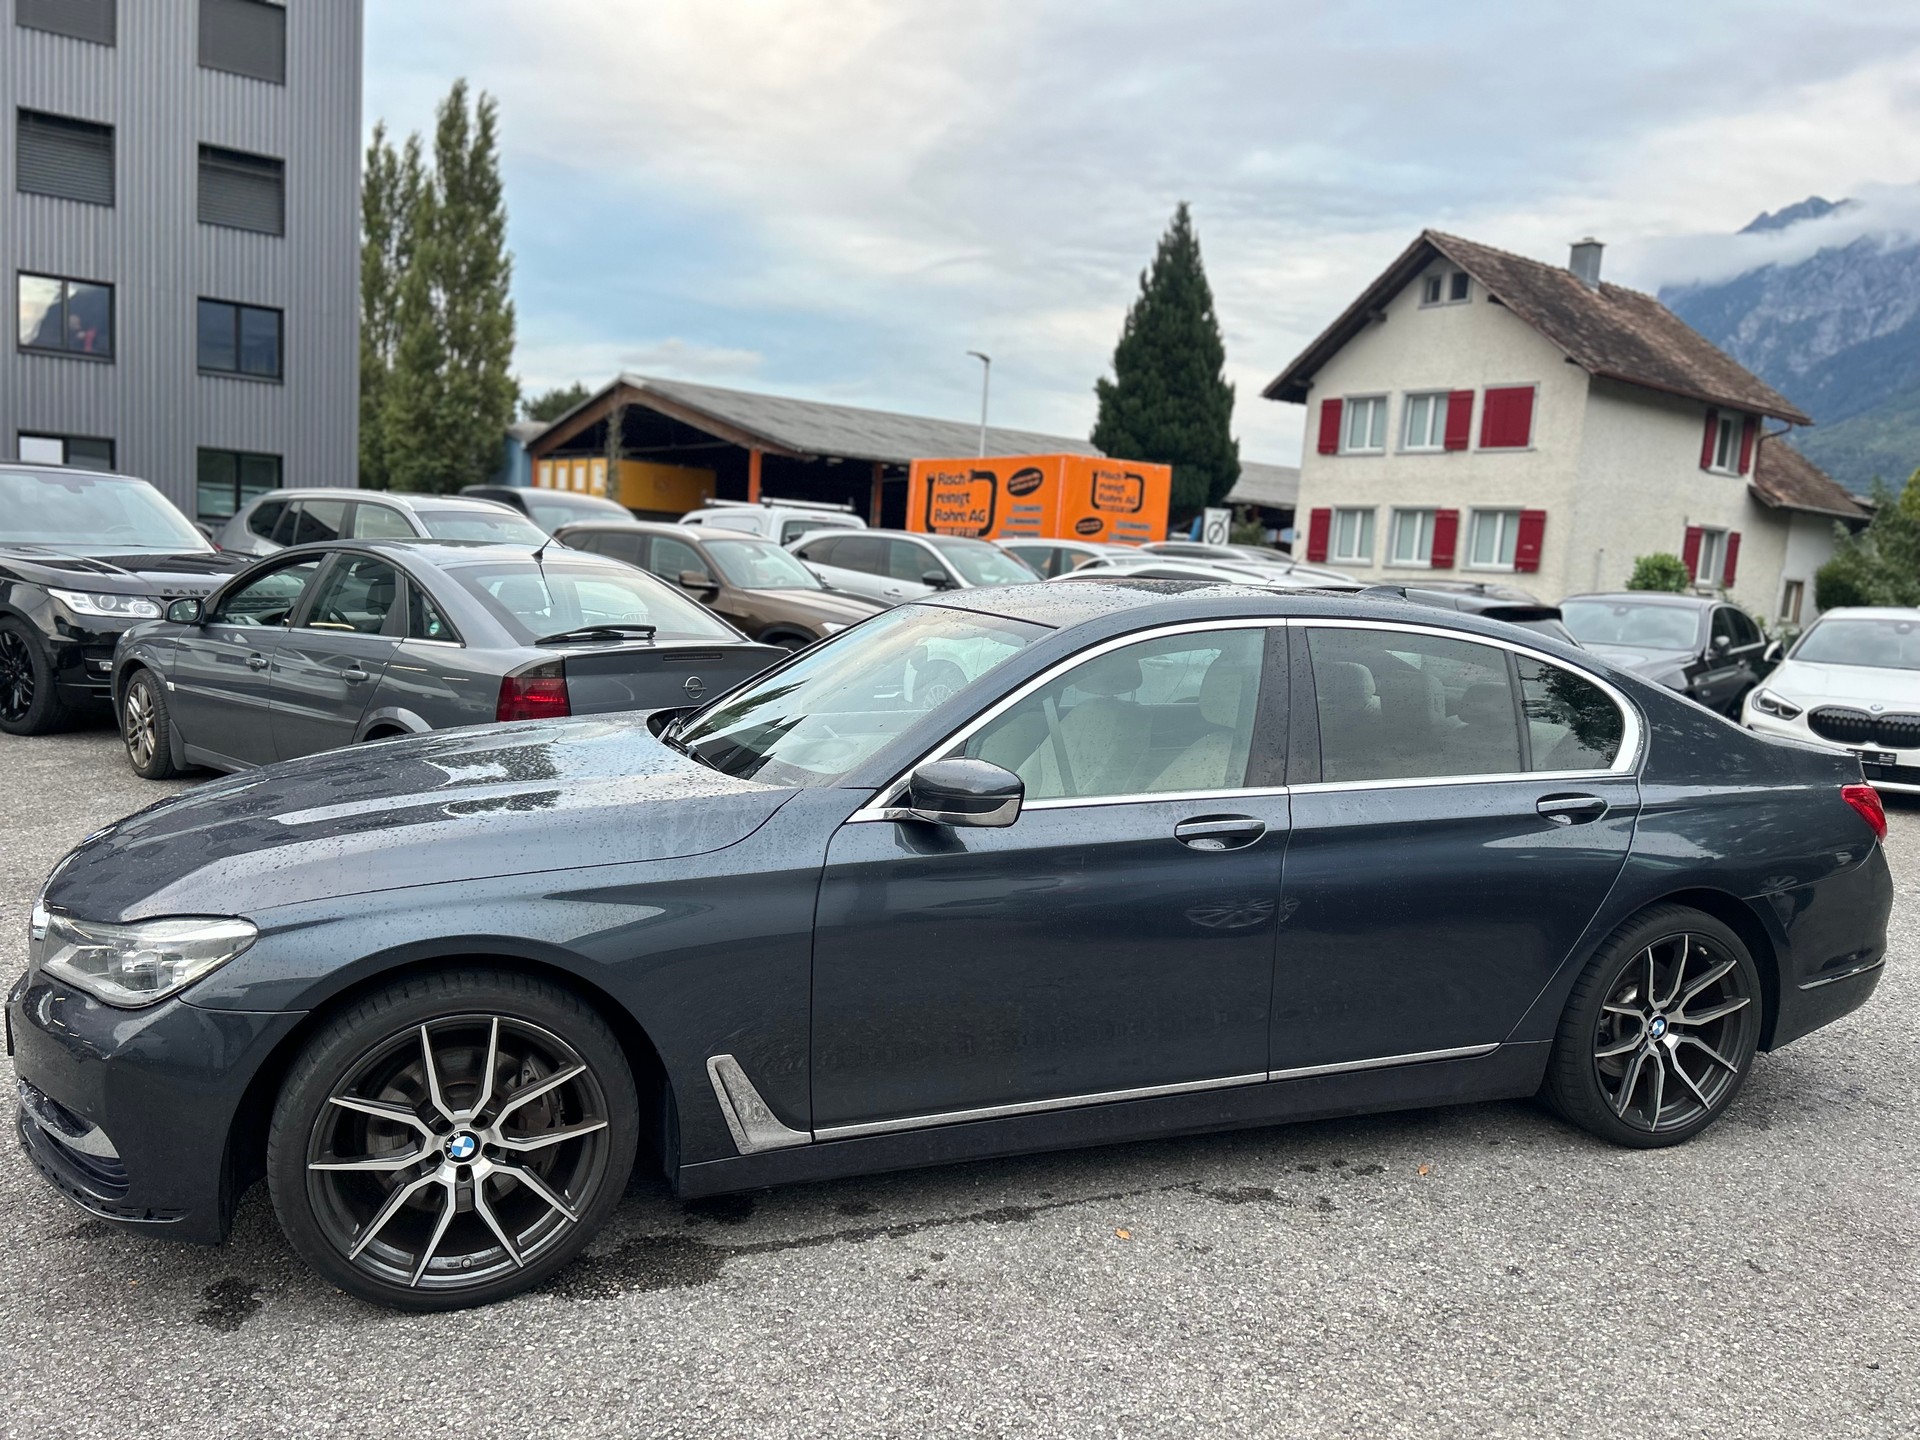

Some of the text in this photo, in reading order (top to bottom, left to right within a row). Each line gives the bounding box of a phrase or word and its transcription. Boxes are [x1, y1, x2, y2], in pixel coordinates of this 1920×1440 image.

[937, 472, 966, 485] Risch
[936, 492, 971, 507] reinigt
[968, 509, 986, 522] AG
[163, 588, 212, 596] RANG
